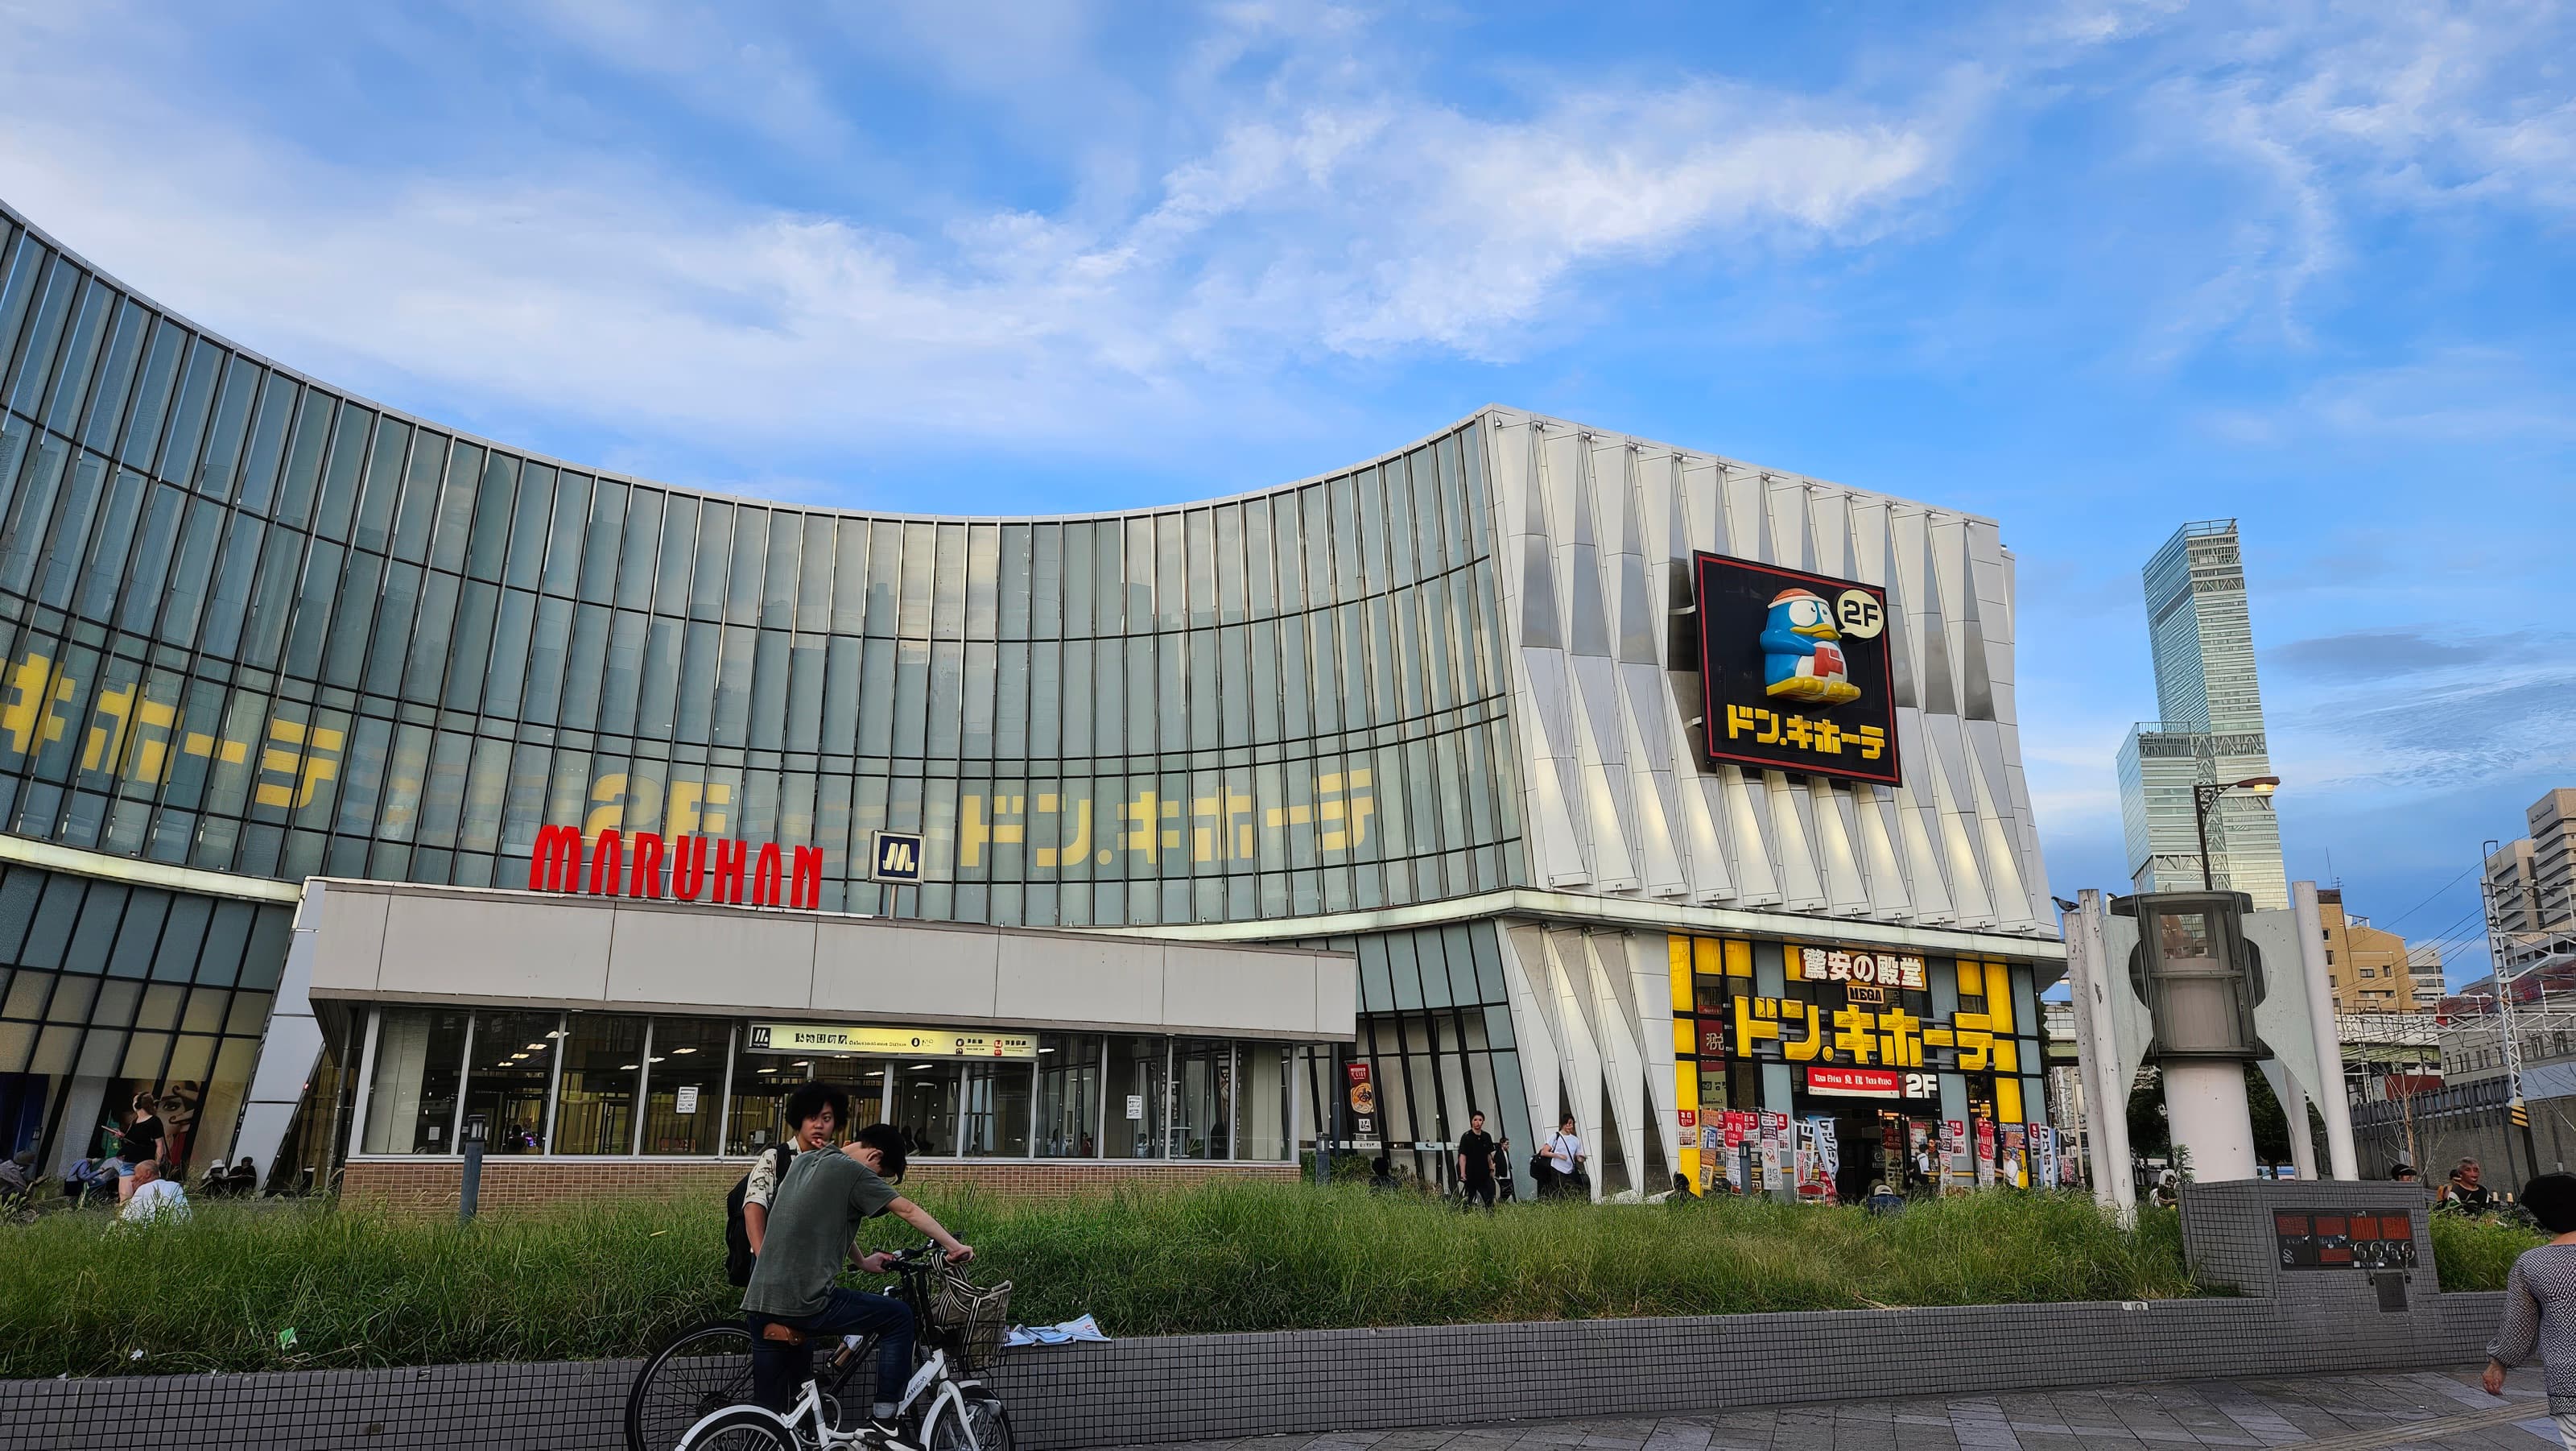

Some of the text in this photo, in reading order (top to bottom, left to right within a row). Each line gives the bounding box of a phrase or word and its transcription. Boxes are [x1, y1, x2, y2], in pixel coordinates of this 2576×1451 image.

[1843, 600, 1880, 627] 2F
[528, 824, 824, 910] MARUHAN
[1803, 949, 1923, 987] 驚安の殿堂
[1849, 987, 1881, 1002] MEGA
[1905, 1073, 1938, 1098] 2F
